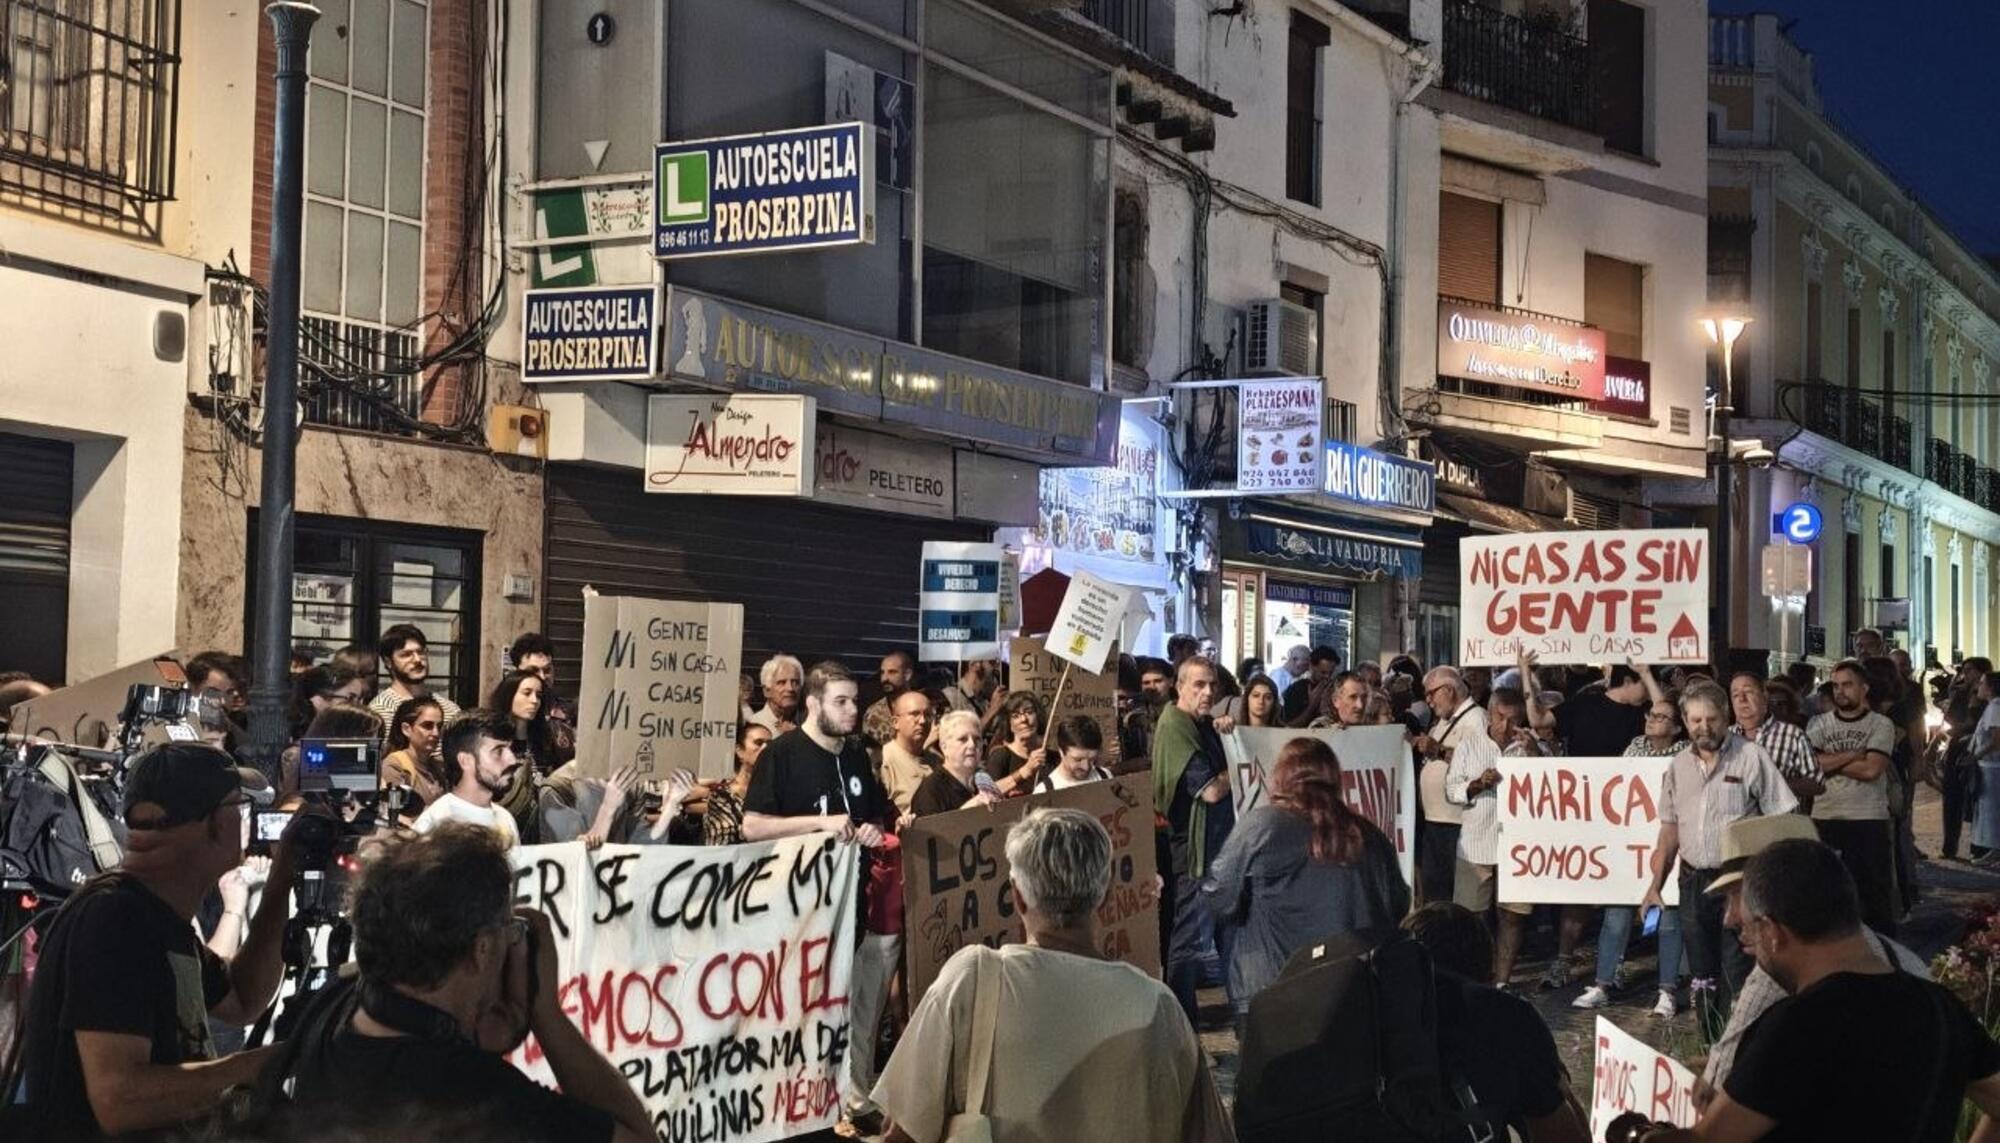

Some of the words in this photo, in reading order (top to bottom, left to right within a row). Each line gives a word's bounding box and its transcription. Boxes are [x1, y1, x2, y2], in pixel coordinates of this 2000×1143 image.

[714, 134, 857, 190] AUTOESCUELA
[667, 162, 703, 216] L
[713, 190, 856, 243] PROSERPINA
[659, 231, 675, 248] 696
[689, 230, 698, 245] 11
[699, 228, 710, 244] 13
[529, 297, 648, 333] AUTOESCUELA
[527, 334, 647, 370] PROSERPINA
[711, 400, 725, 414] New
[726, 407, 754, 425] Design
[1246, 398, 1275, 409] PLAZA
[1276, 386, 1316, 409] ESPAÑA
[869, 469, 944, 498] PELETERO
[1358, 455, 1429, 510] GUERRERO
[1789, 508, 1815, 538] 2
[1317, 537, 1402, 567] LAVANDERIA
[1487, 589, 1663, 635] GENTE
[648, 618, 709, 641] GENTE
[683, 653, 728, 674] CASA
[1020, 652, 1039, 672] SI
[1465, 638, 1485, 662] NI
[1541, 637, 1572, 656] SIN
[1589, 634, 1645, 656] CASAS
[648, 682, 703, 705] CASAS
[639, 712, 675, 739] SIN
[680, 718, 737, 740] GENTE
[927, 827, 997, 896] LOS
[1510, 844, 1610, 881] SOMOS
[593, 853, 641, 926] SE
[651, 854, 780, 931] COME
[699, 937, 787, 1022] CON
[799, 931, 849, 1014] EL
[620, 1023, 807, 1098] PLATAFORMA
[817, 1020, 850, 1065] DE
